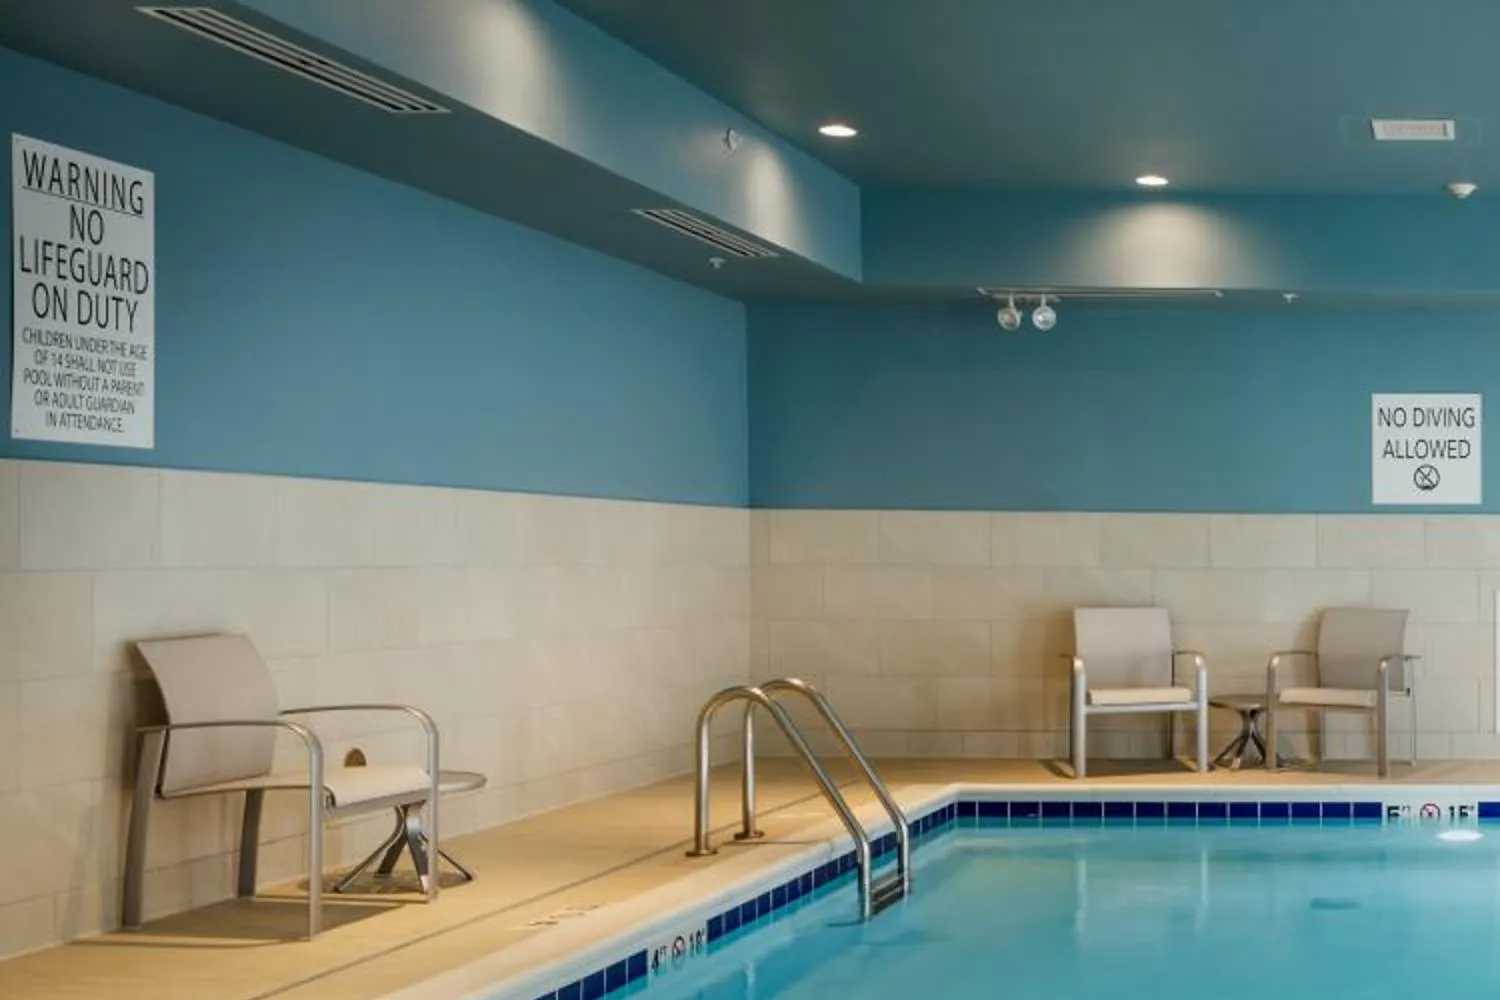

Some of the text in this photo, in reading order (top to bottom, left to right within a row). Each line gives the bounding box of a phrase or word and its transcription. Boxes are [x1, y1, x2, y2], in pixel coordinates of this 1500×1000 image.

[22, 149, 144, 215] WARNING
[69, 204, 104, 245] NO
[20, 235, 149, 295] LIFEGUARD
[32, 283, 138, 333] ON DUTY
[22, 327, 73, 349] CHILDREN
[74, 336, 109, 354] UNDER
[109, 340, 127, 357] THE
[34, 348, 49, 365] OF
[97, 358, 118, 374] NOT
[24, 367, 53, 387] POOL
[54, 372, 101, 393] WITHOUT
[101, 378, 109, 393] A
[34, 388, 50, 405] OR
[52, 392, 85, 410] ADULT
[45, 411, 58, 427] IN
[1378, 407, 1476, 429] NO DIVING
[1382, 438, 1471, 459] ALLOWED
